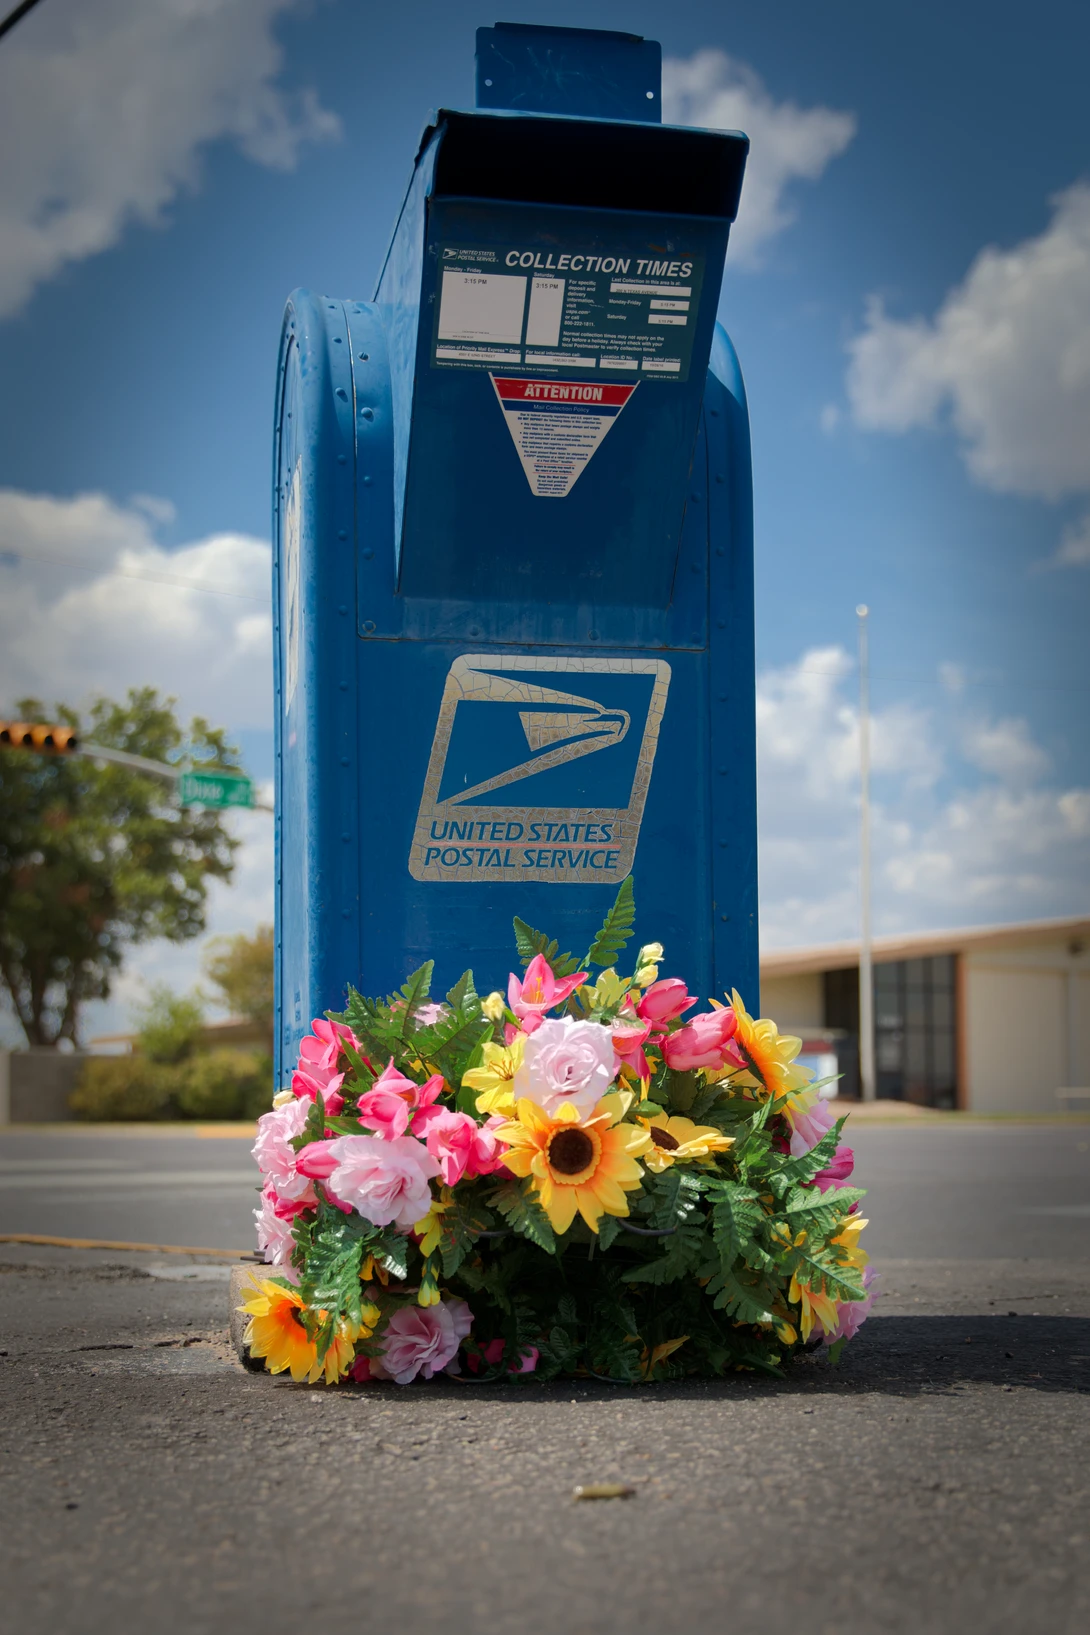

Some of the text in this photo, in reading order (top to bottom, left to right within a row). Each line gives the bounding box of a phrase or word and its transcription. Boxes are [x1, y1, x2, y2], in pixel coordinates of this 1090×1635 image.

[505, 251, 693, 278] COLLECTION TIMES
[524, 384, 603, 401] ATTENTION
[430, 821, 613, 842] UNITED STATES
[424, 848, 620, 869] POSTAL SERVICE
